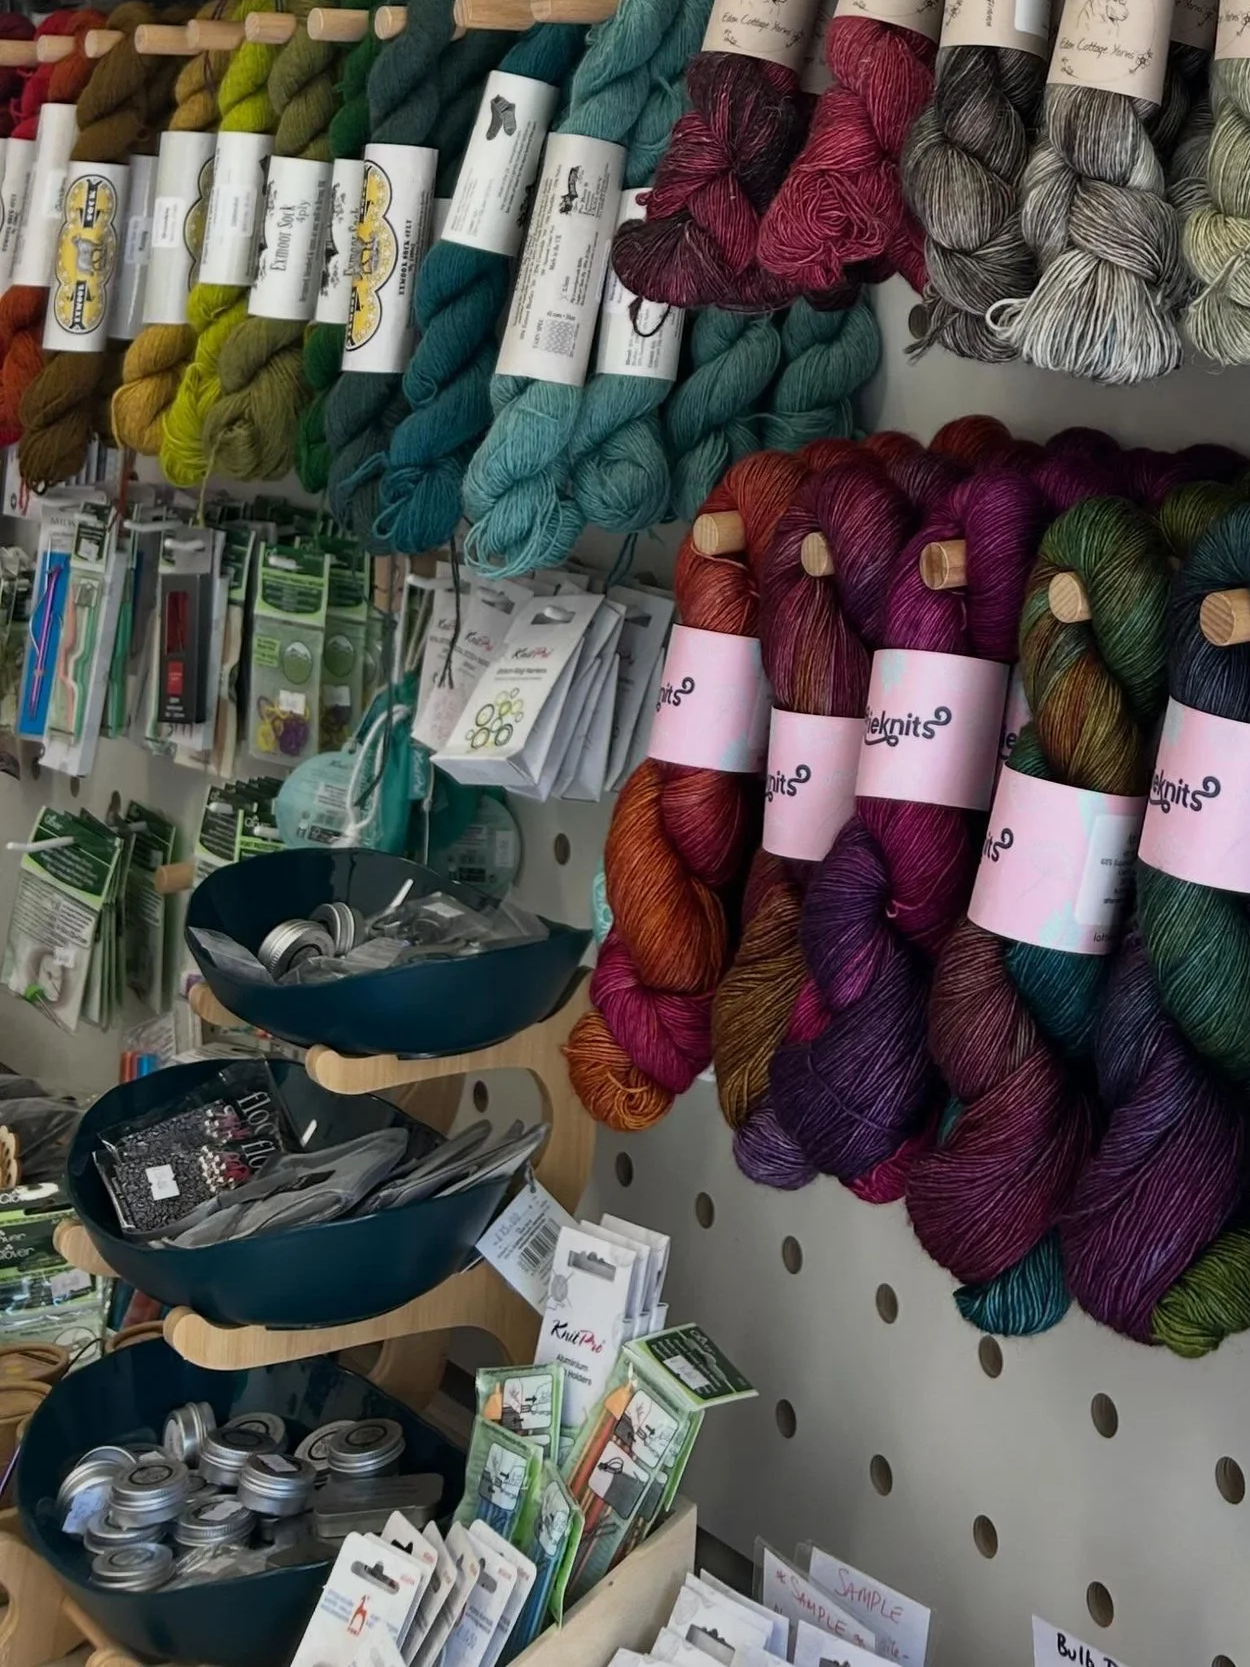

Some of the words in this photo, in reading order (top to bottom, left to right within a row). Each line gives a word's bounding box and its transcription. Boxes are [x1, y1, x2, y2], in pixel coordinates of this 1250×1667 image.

[741, 14, 769, 32] Cottage
[1077, 37, 1108, 58] Cottage
[1111, 44, 1135, 59] Yarns
[86, 190, 96, 222] SOCK
[277, 205, 297, 229] Sock
[295, 201, 311, 222] 4ply
[270, 233, 291, 271] Exmoor
[551, 1319, 604, 1353] KnitPro
[790, 1575, 849, 1636] SAMPLE
[834, 1568, 904, 1624] SAMPLE
[1057, 1632, 1095, 1667] Bulb
